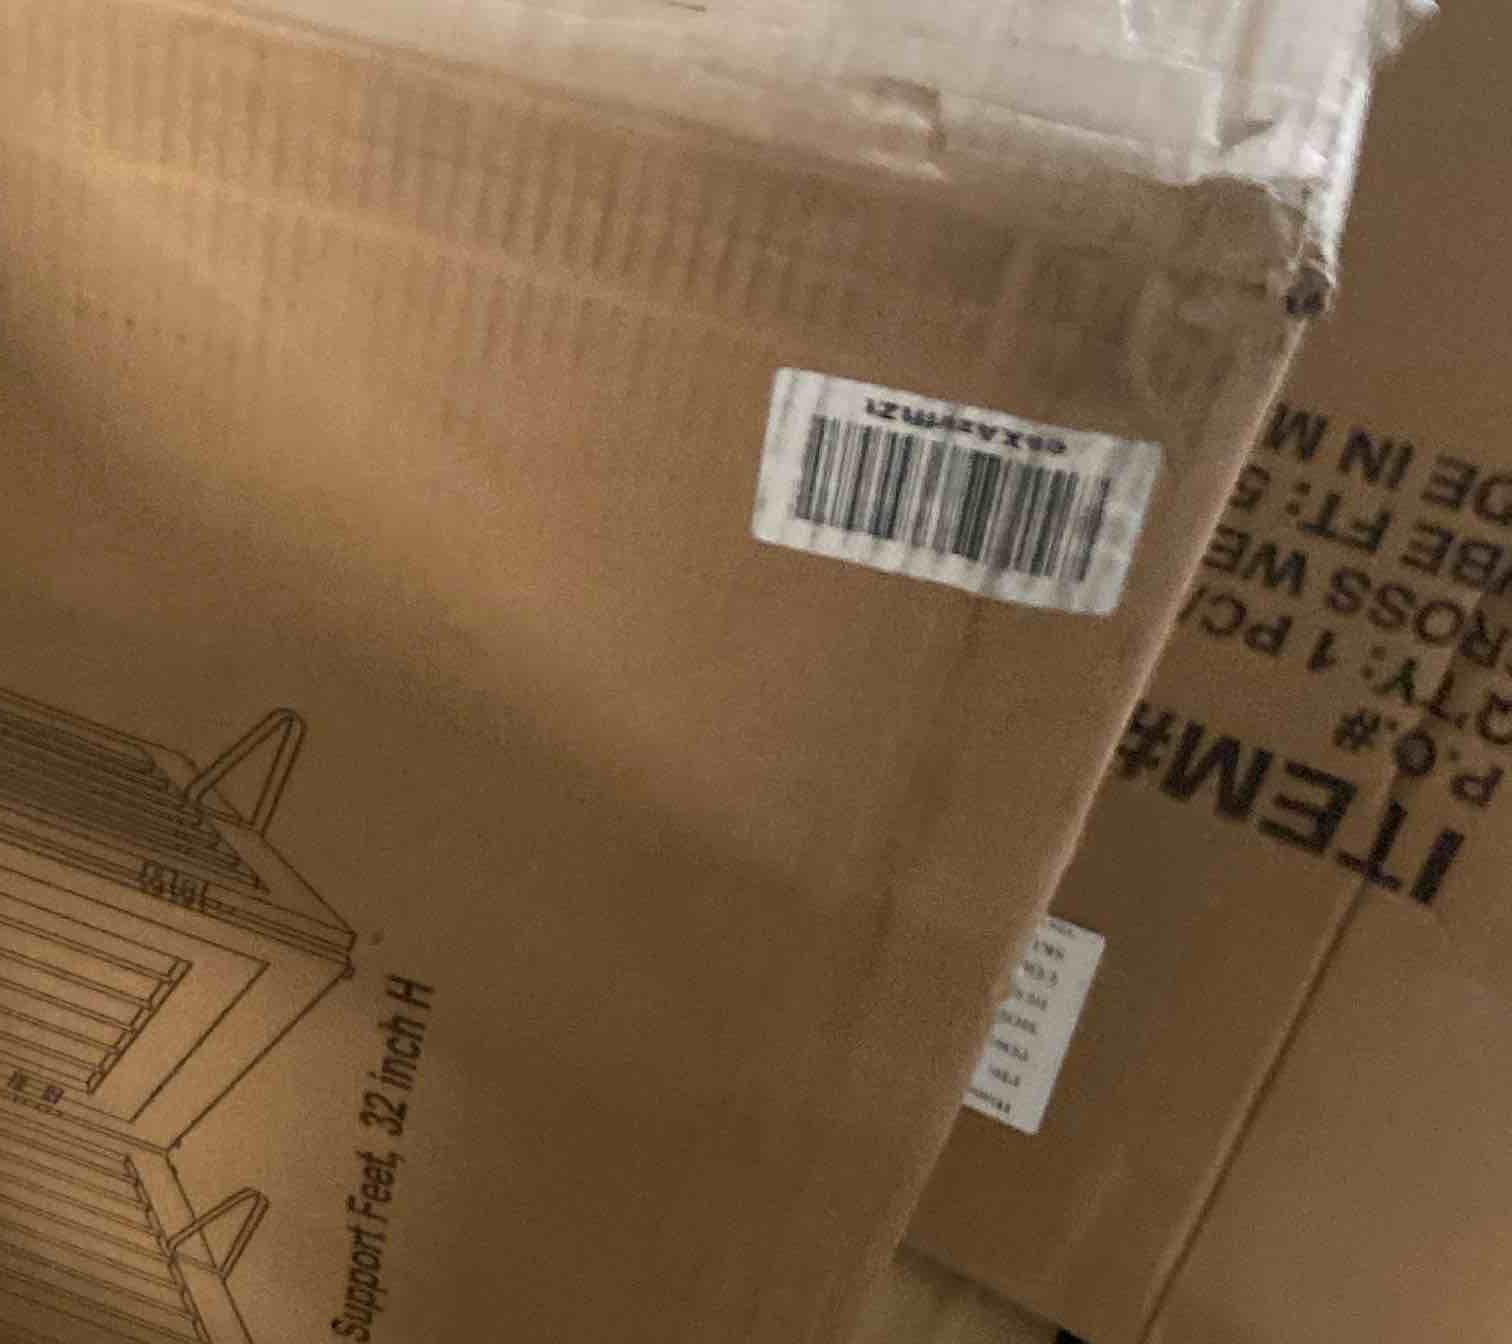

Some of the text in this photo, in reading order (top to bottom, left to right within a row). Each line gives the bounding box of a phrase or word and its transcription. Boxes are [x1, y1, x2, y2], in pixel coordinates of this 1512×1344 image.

[1336, 425, 1415, 490] IN
[1287, 480, 1392, 554] FT:
[1203, 524, 1512, 680] ROSS WE
[1307, 628, 1337, 673] 1
[1361, 645, 1512, 746] QTY:
[1333, 706, 1506, 808] P.O.#
[1115, 701, 1465, 905] ITEM#
[387, 973, 435, 1010] H
[368, 1013, 427, 1092] inch
[359, 1090, 408, 1137] 32
[346, 1150, 405, 1224] Feet,
[332, 1224, 388, 1344] Support
